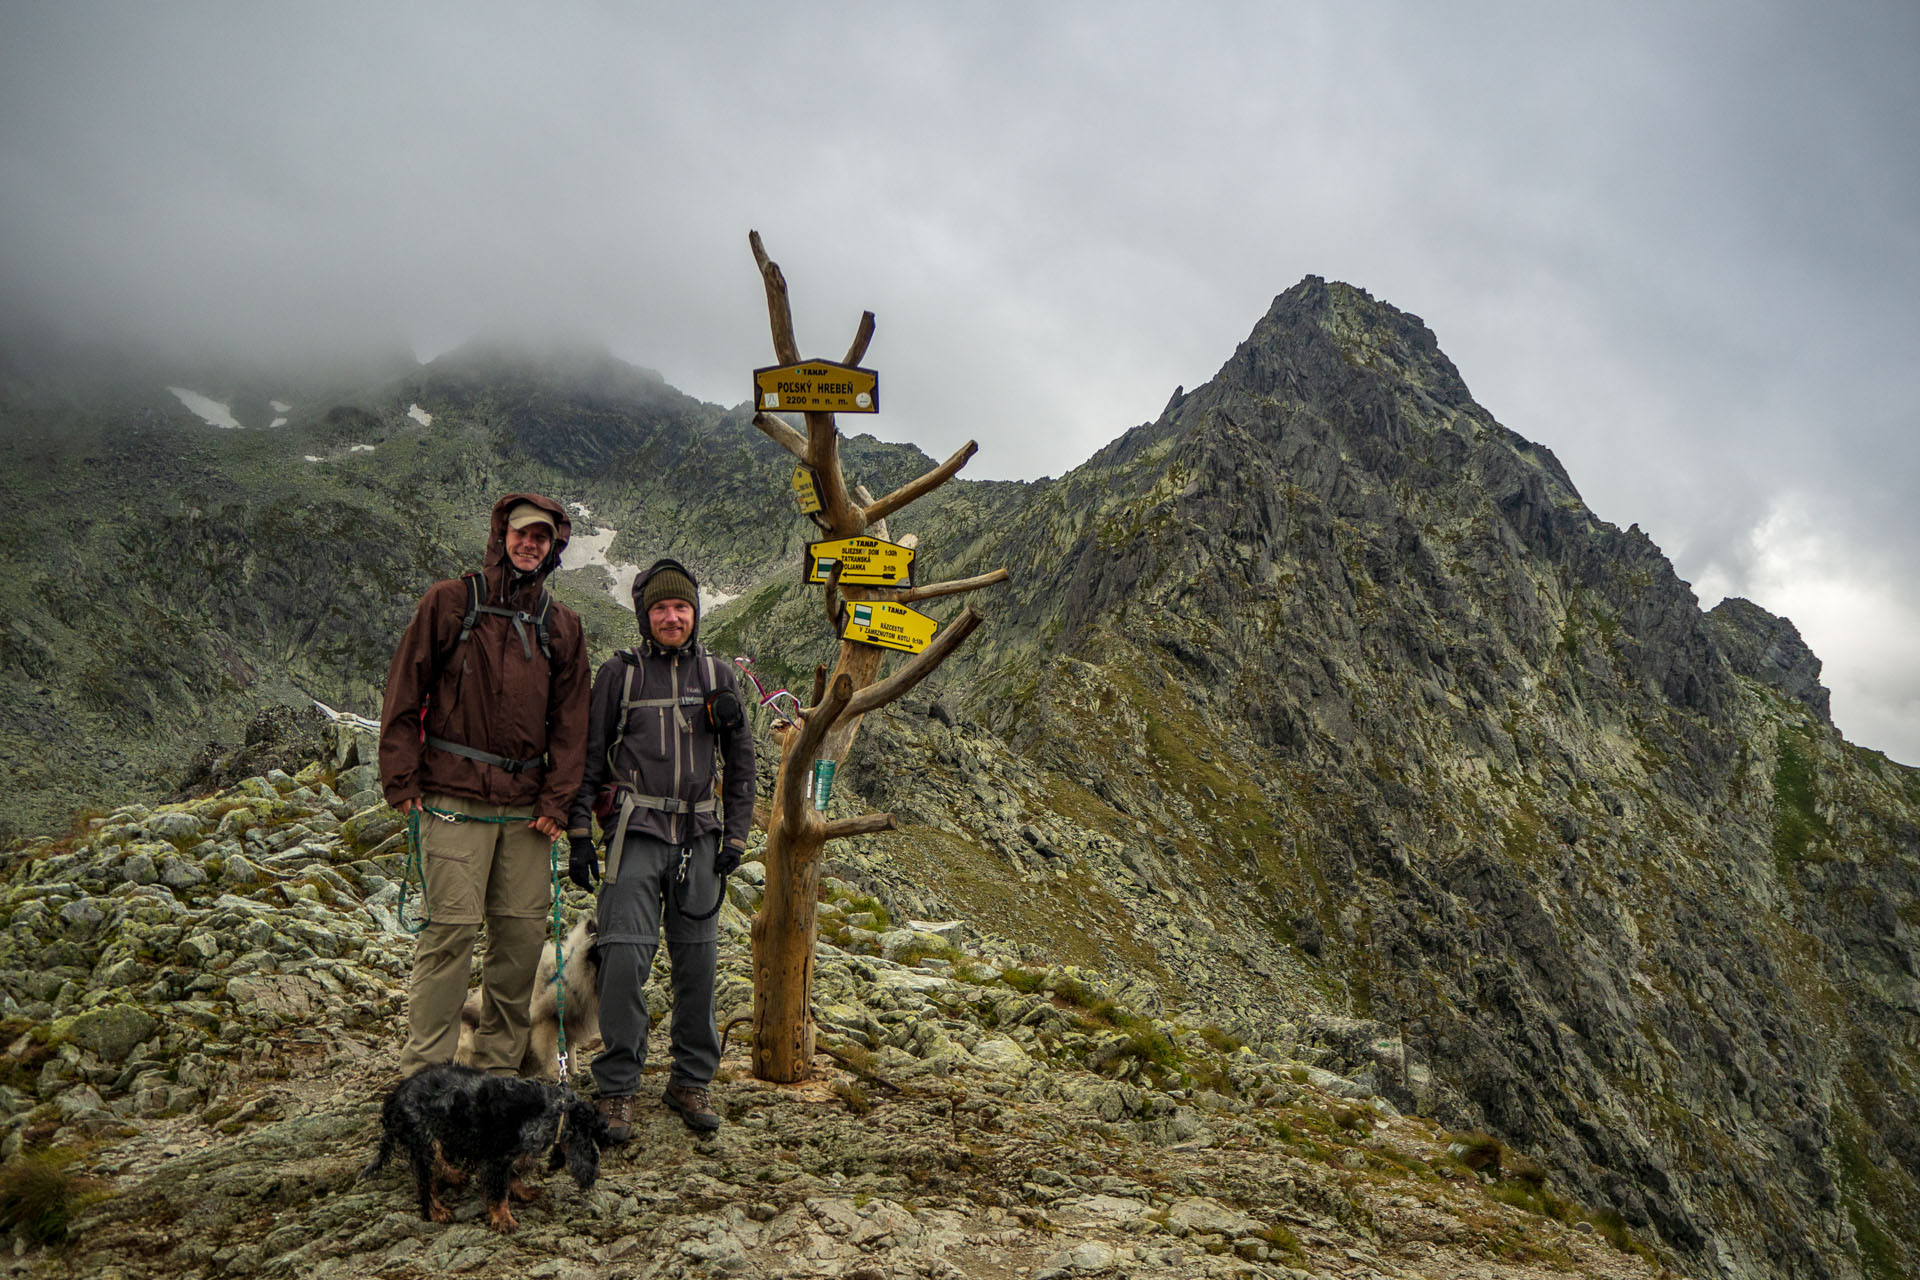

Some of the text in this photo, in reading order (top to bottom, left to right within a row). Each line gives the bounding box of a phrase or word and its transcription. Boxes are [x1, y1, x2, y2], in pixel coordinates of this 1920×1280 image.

[777, 380, 854, 394] POĽSKÝ HREBEŇ
[786, 396, 807, 405] 2200
[856, 540, 879, 548] TANAP
[841, 555, 871, 563] TATRANSKÁ
[888, 606, 907, 616] TANAP
